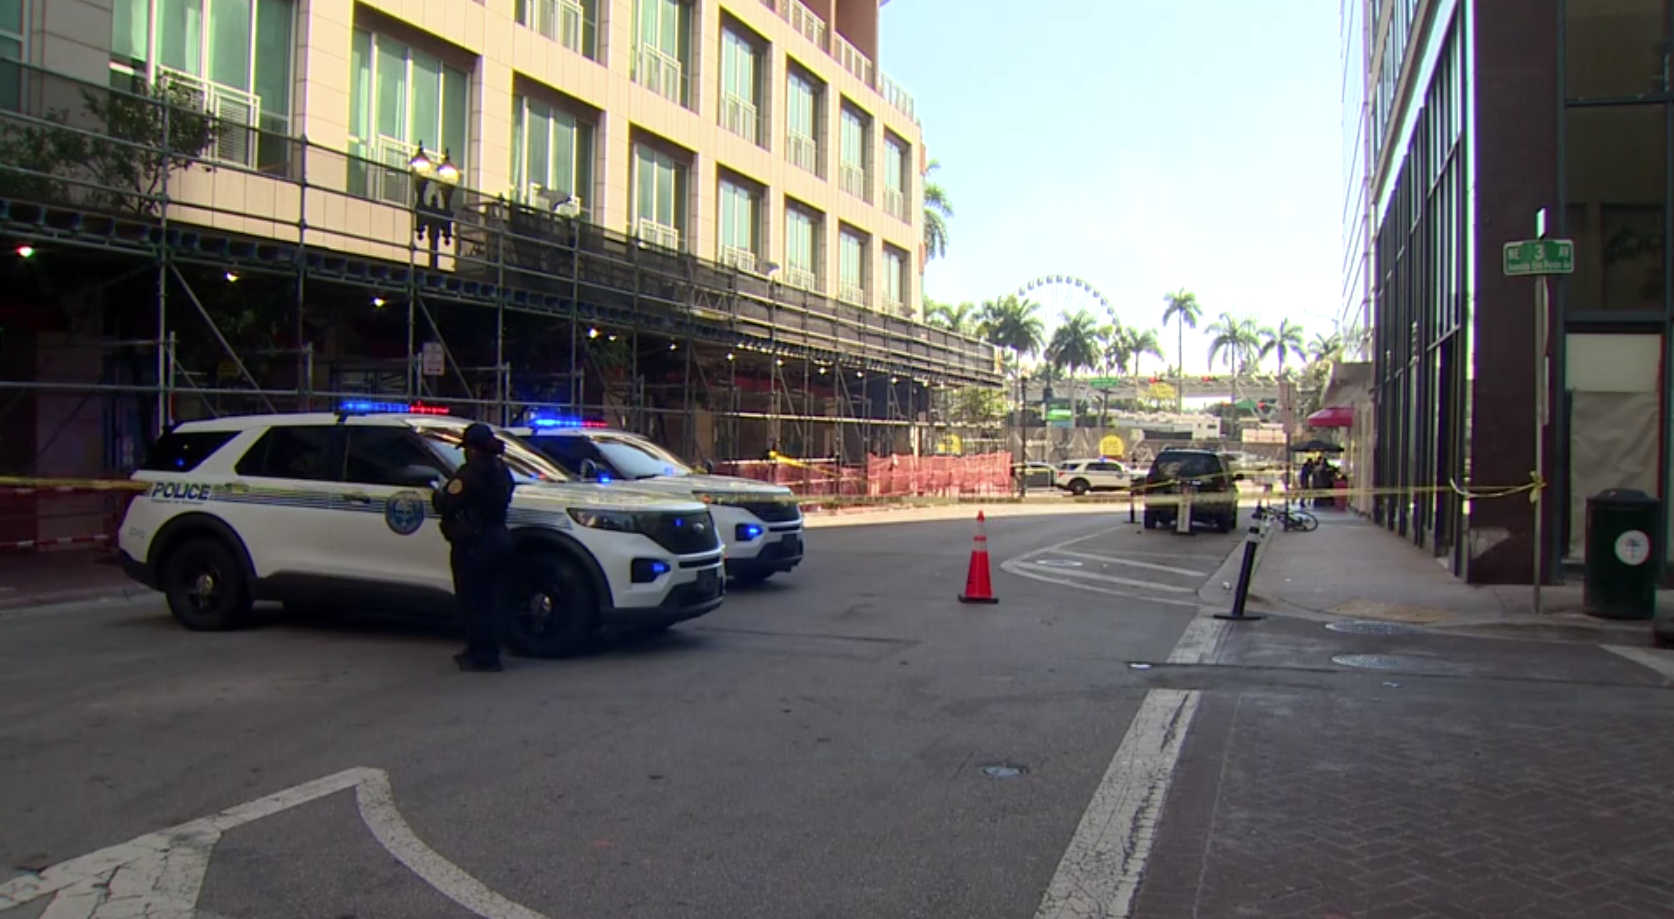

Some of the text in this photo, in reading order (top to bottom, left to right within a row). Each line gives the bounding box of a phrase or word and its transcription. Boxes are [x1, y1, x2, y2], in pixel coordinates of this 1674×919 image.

[1508, 248, 1521, 260] NE
[1534, 244, 1544, 260] 3
[152, 482, 211, 501] POLICE
